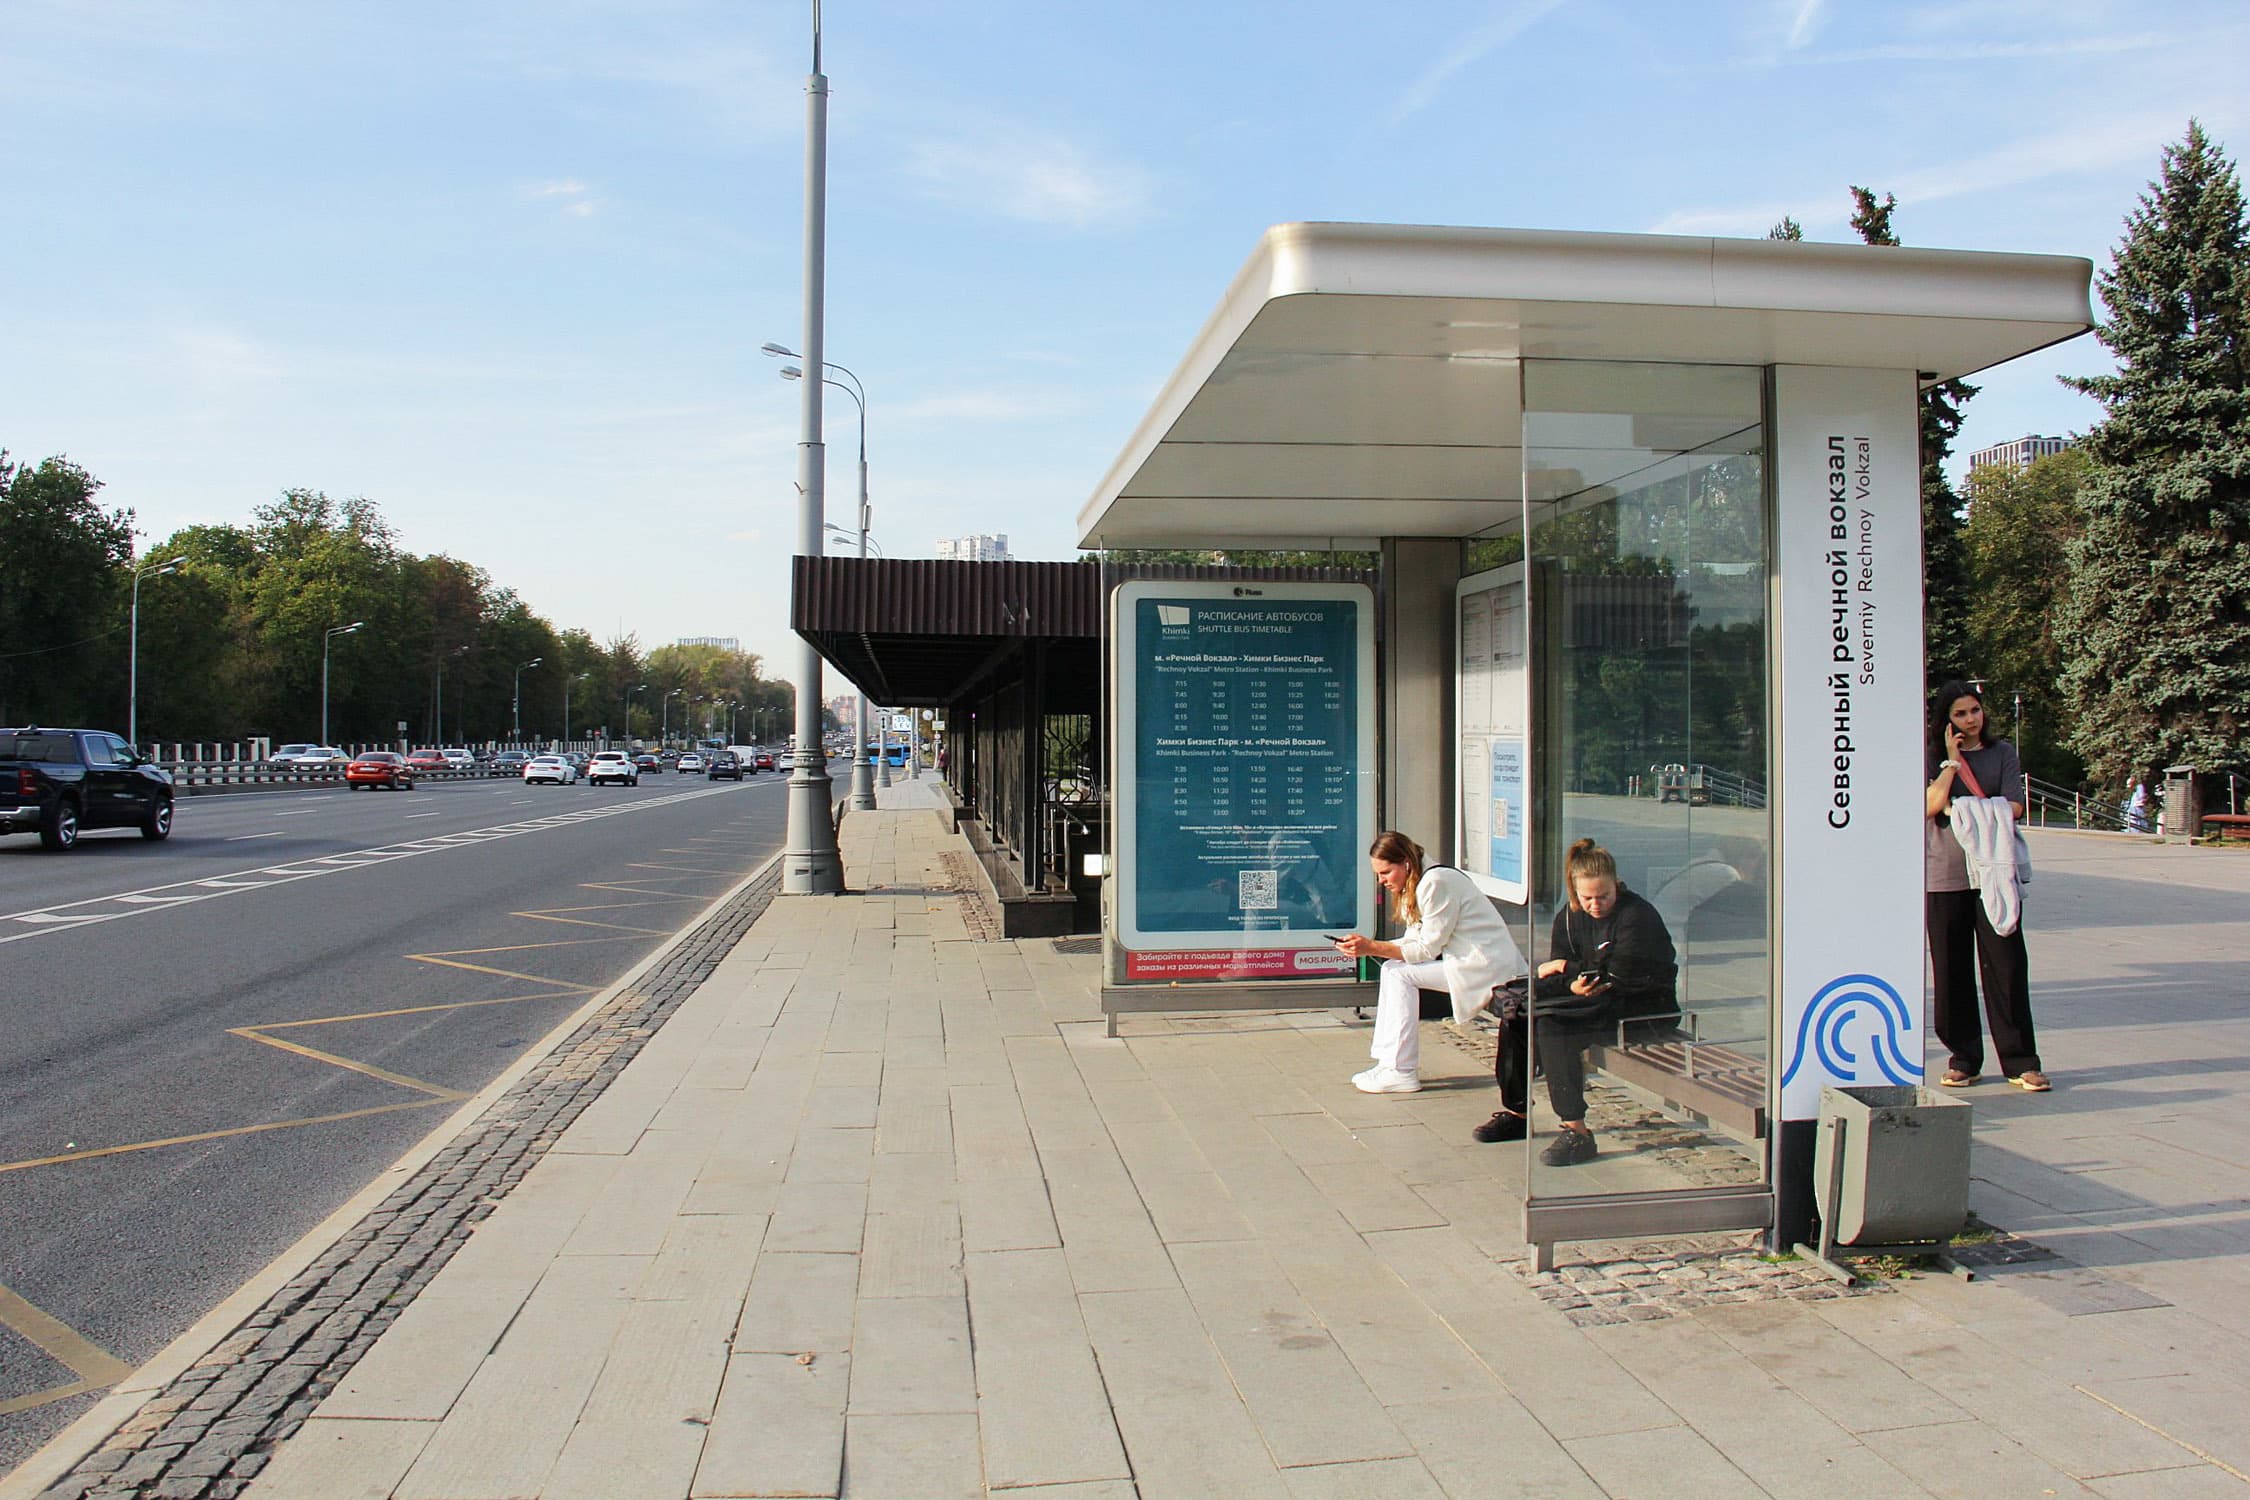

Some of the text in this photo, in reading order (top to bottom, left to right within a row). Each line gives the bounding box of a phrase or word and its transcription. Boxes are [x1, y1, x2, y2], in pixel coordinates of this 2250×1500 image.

[1856, 437, 1876, 684] Severniy Rechnoy Vokzal
[1198, 612, 1324, 622] РАСПИСАНИЕ АВТОБУСОВ
[1826, 436, 1855, 829] Северный речной вокзал
[1166, 654, 1200, 664] «Речной
[1203, 654, 1238, 664] Вокзал»
[1244, 654, 1272, 664] Химки
[1274, 654, 1301, 664] Бизнес
[1304, 654, 1324, 664] Парк
[1157, 737, 1185, 747] Химки
[1187, 737, 1216, 747] Бизнес
[1218, 737, 1239, 747] Парк
[1256, 737, 1290, 747] «Речной
[1292, 737, 1326, 747] Вокзал»
[1156, 749, 1179, 757] Khimki
[1181, 749, 1208, 757] Business
[1210, 749, 1226, 757] Park
[1290, 749, 1308, 757] Metro
[1310, 749, 1334, 757] Station
[1223, 962, 1284, 970] маркетплейсов
